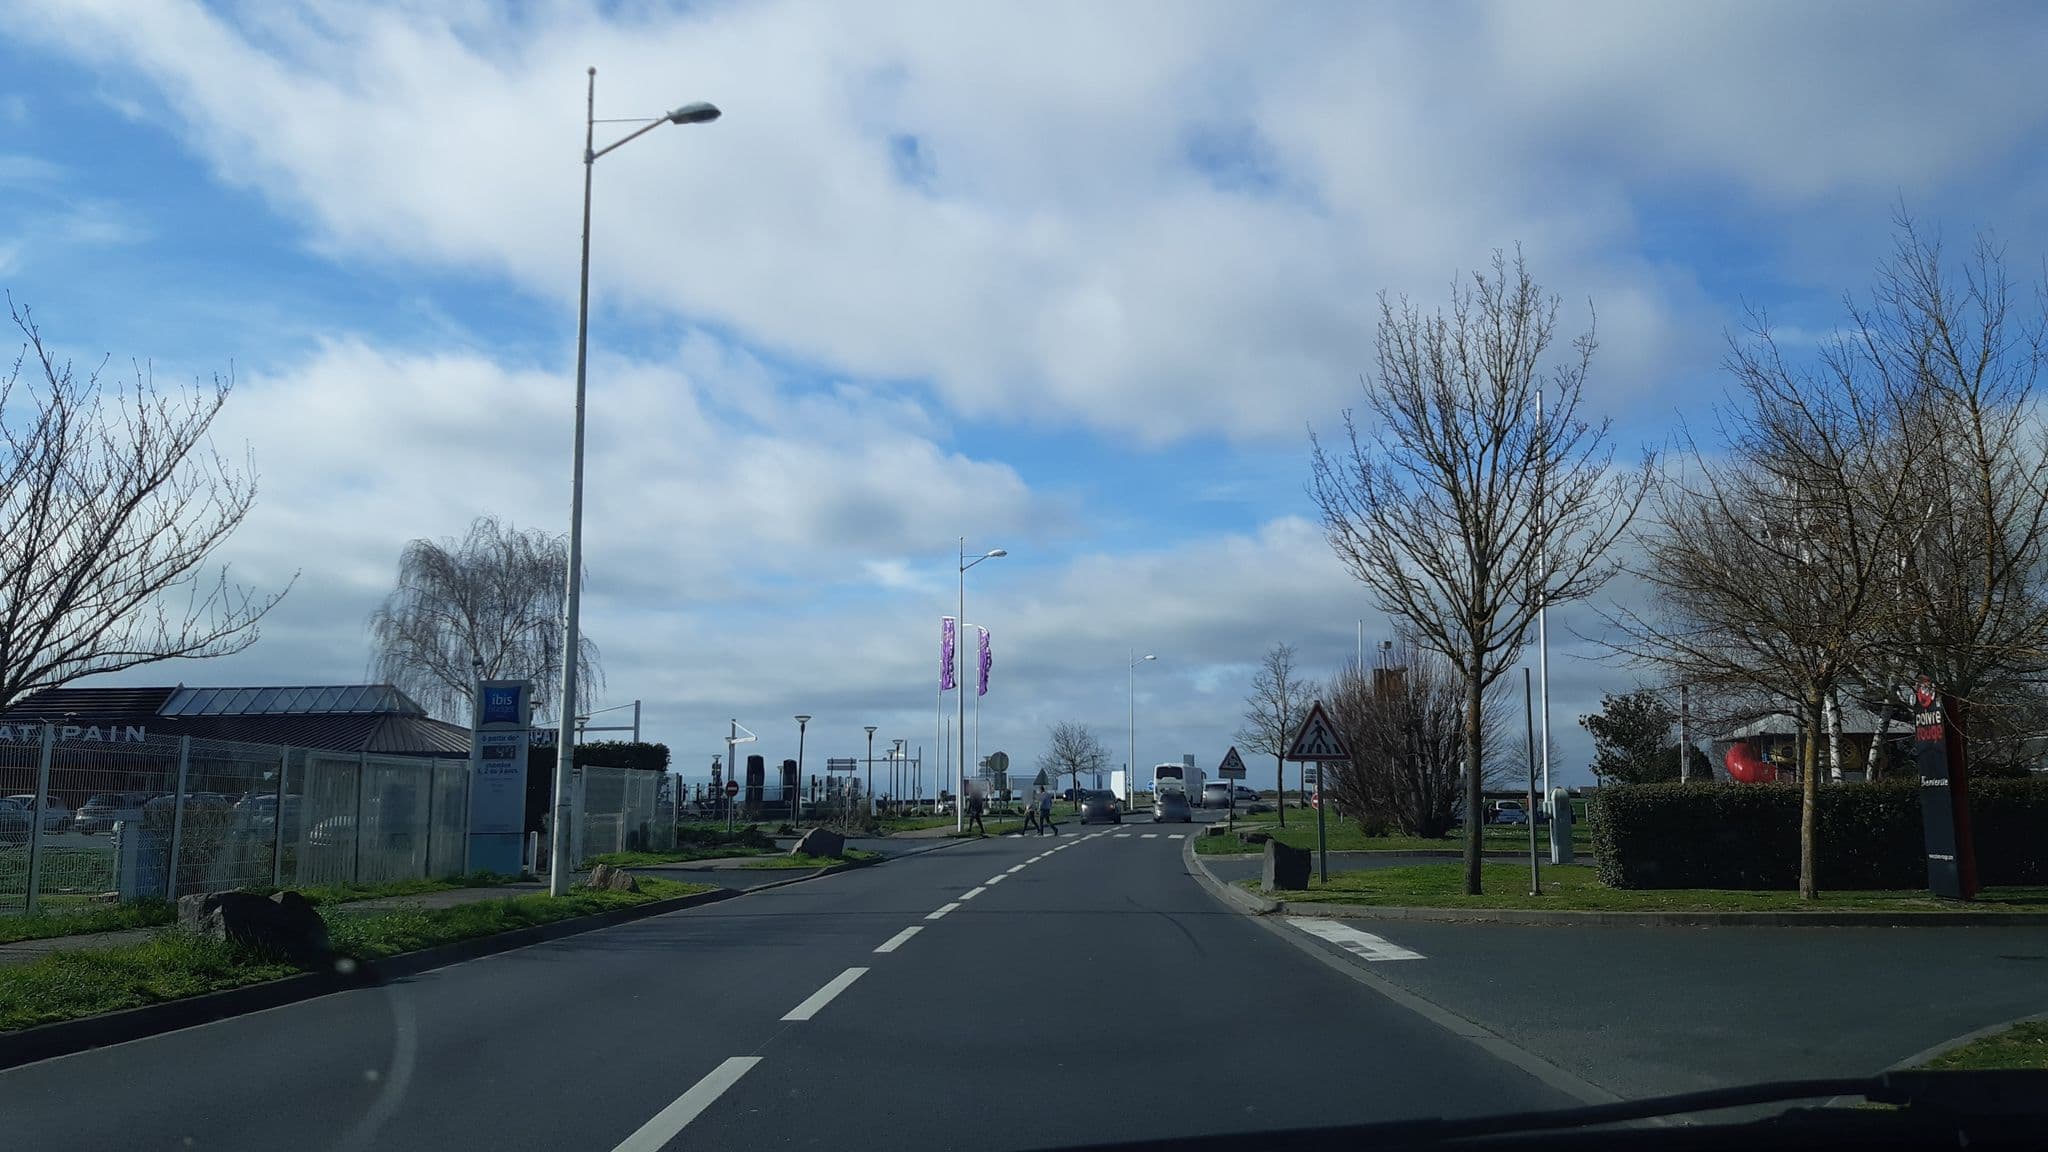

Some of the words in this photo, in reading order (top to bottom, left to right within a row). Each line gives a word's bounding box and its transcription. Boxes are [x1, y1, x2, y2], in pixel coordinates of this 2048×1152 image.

[491, 694, 513, 706] ibis
[1915, 710, 1942, 726] poivre
[1916, 724, 1943, 743] rouge
